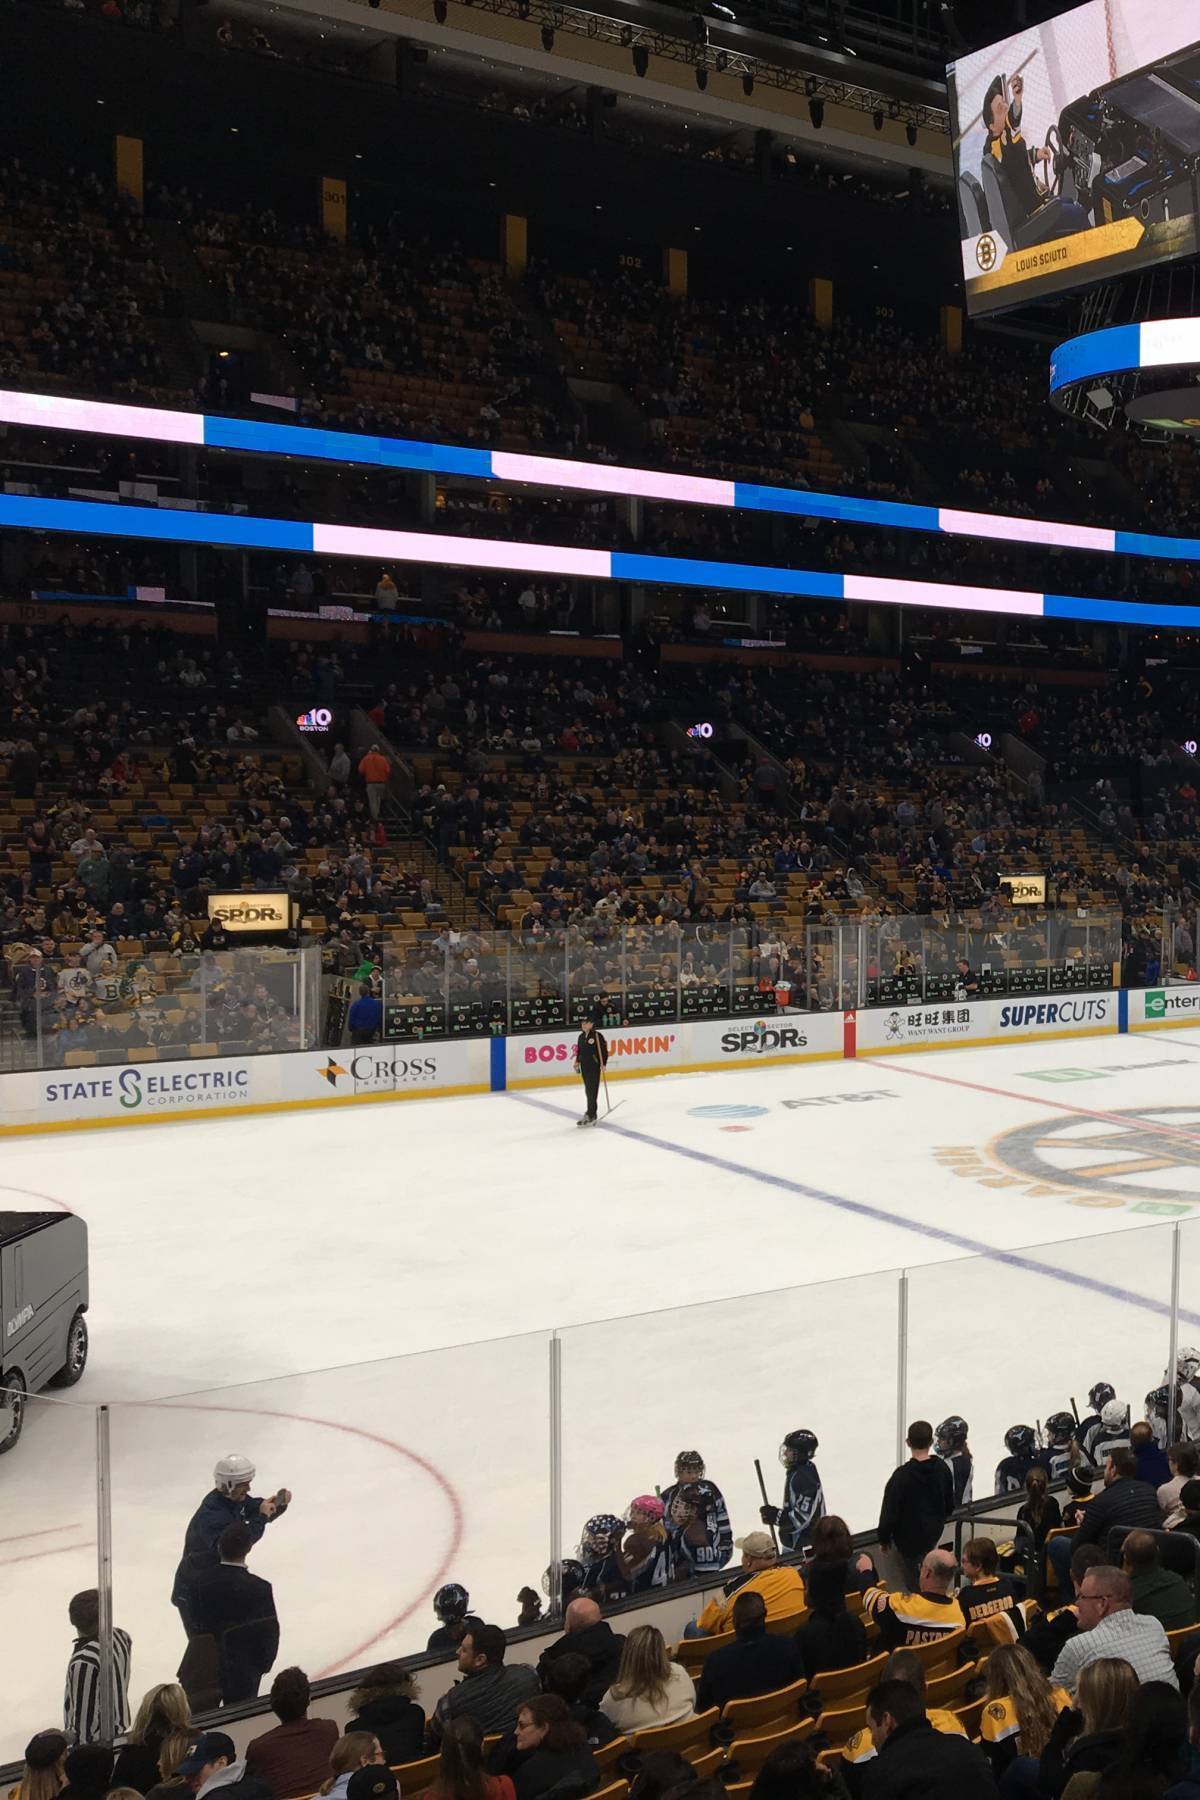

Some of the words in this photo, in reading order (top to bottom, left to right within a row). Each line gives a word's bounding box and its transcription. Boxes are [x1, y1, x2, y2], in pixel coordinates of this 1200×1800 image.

[1015, 256, 1037, 273] LOUIS
[1039, 247, 1067, 268] SCIUTO
[308, 708, 332, 726] 10
[977, 733, 992, 747] 10
[1185, 740, 1198, 754] 10
[907, 1008, 971, 1027] 旺旺集团
[1000, 999, 1107, 1027] SUPERCUTS
[908, 1029, 927, 1037] WANT
[928, 1027, 946, 1035] WANT
[947, 1025, 970, 1034] GROUP
[524, 1043, 568, 1064] BOS
[607, 1034, 675, 1056] UNKIN'
[46, 1080, 113, 1102] STATE
[147, 1070, 248, 1093] ELECTRIC
[147, 1090, 248, 1106] CORPORATION
[781, 1089, 902, 1110] AT&T
[969, 1595, 1015, 1621] BERGERON
